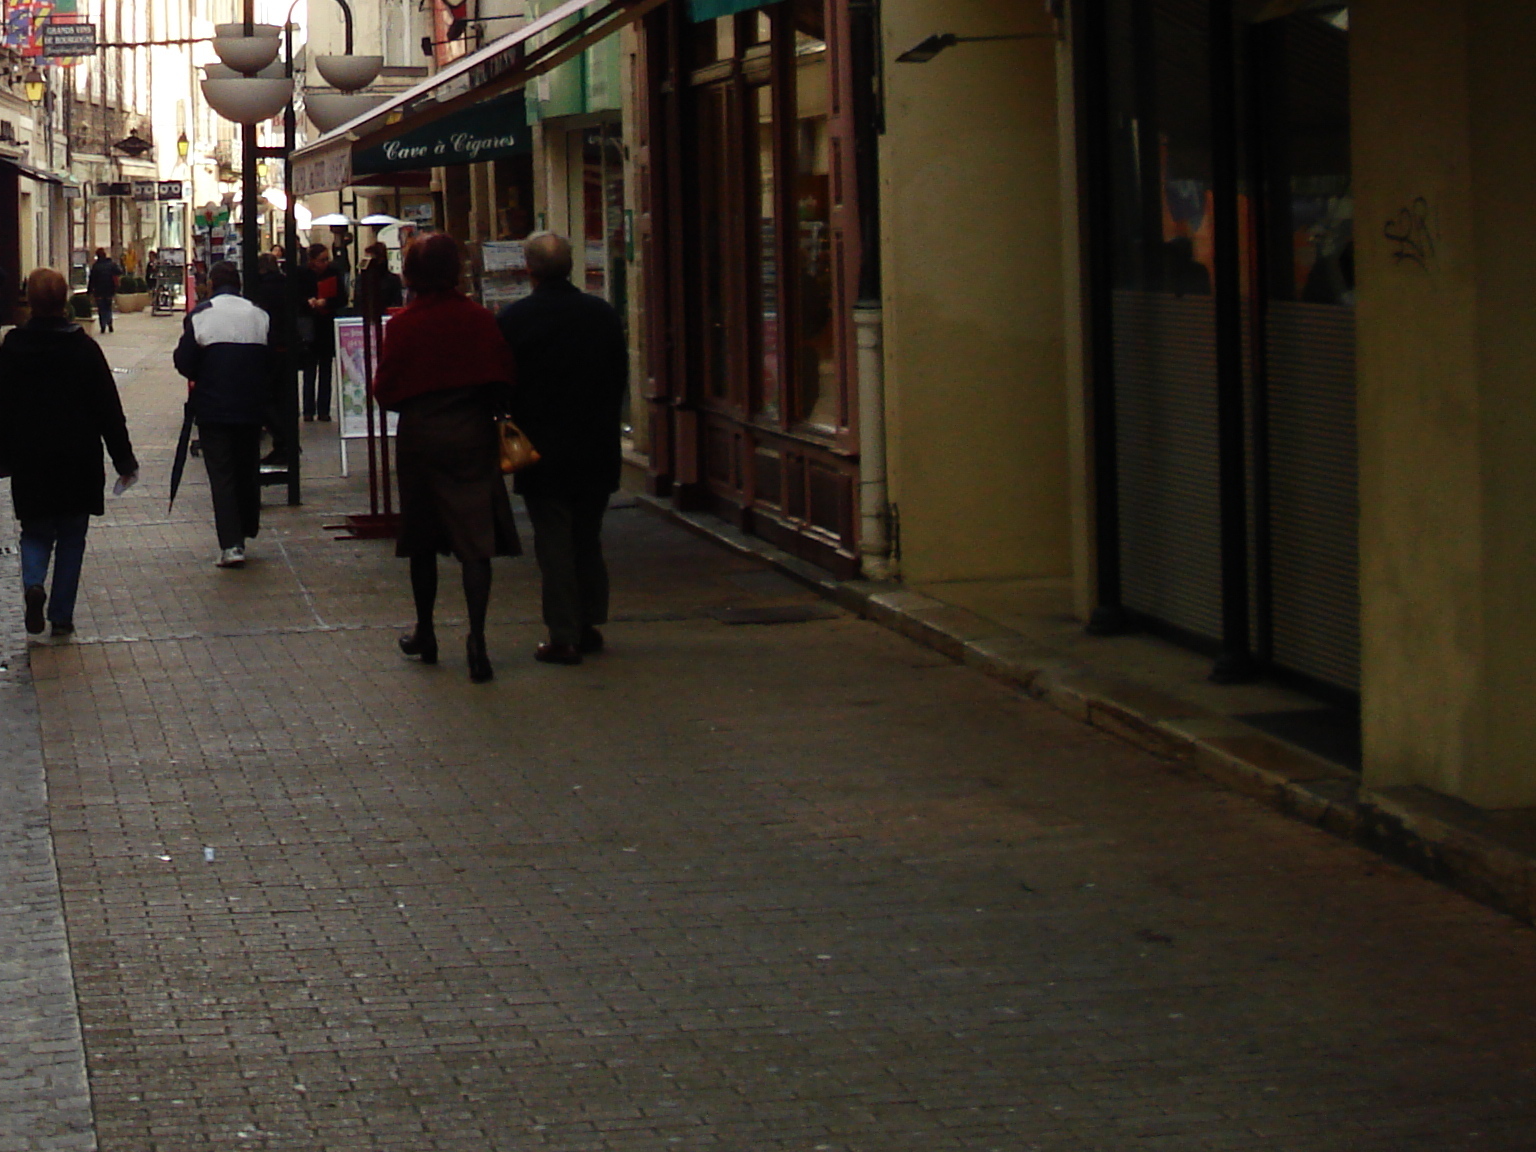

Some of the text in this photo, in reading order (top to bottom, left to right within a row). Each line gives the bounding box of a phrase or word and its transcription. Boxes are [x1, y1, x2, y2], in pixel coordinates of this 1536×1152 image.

[383, 132, 514, 161] Cave à Cigares
